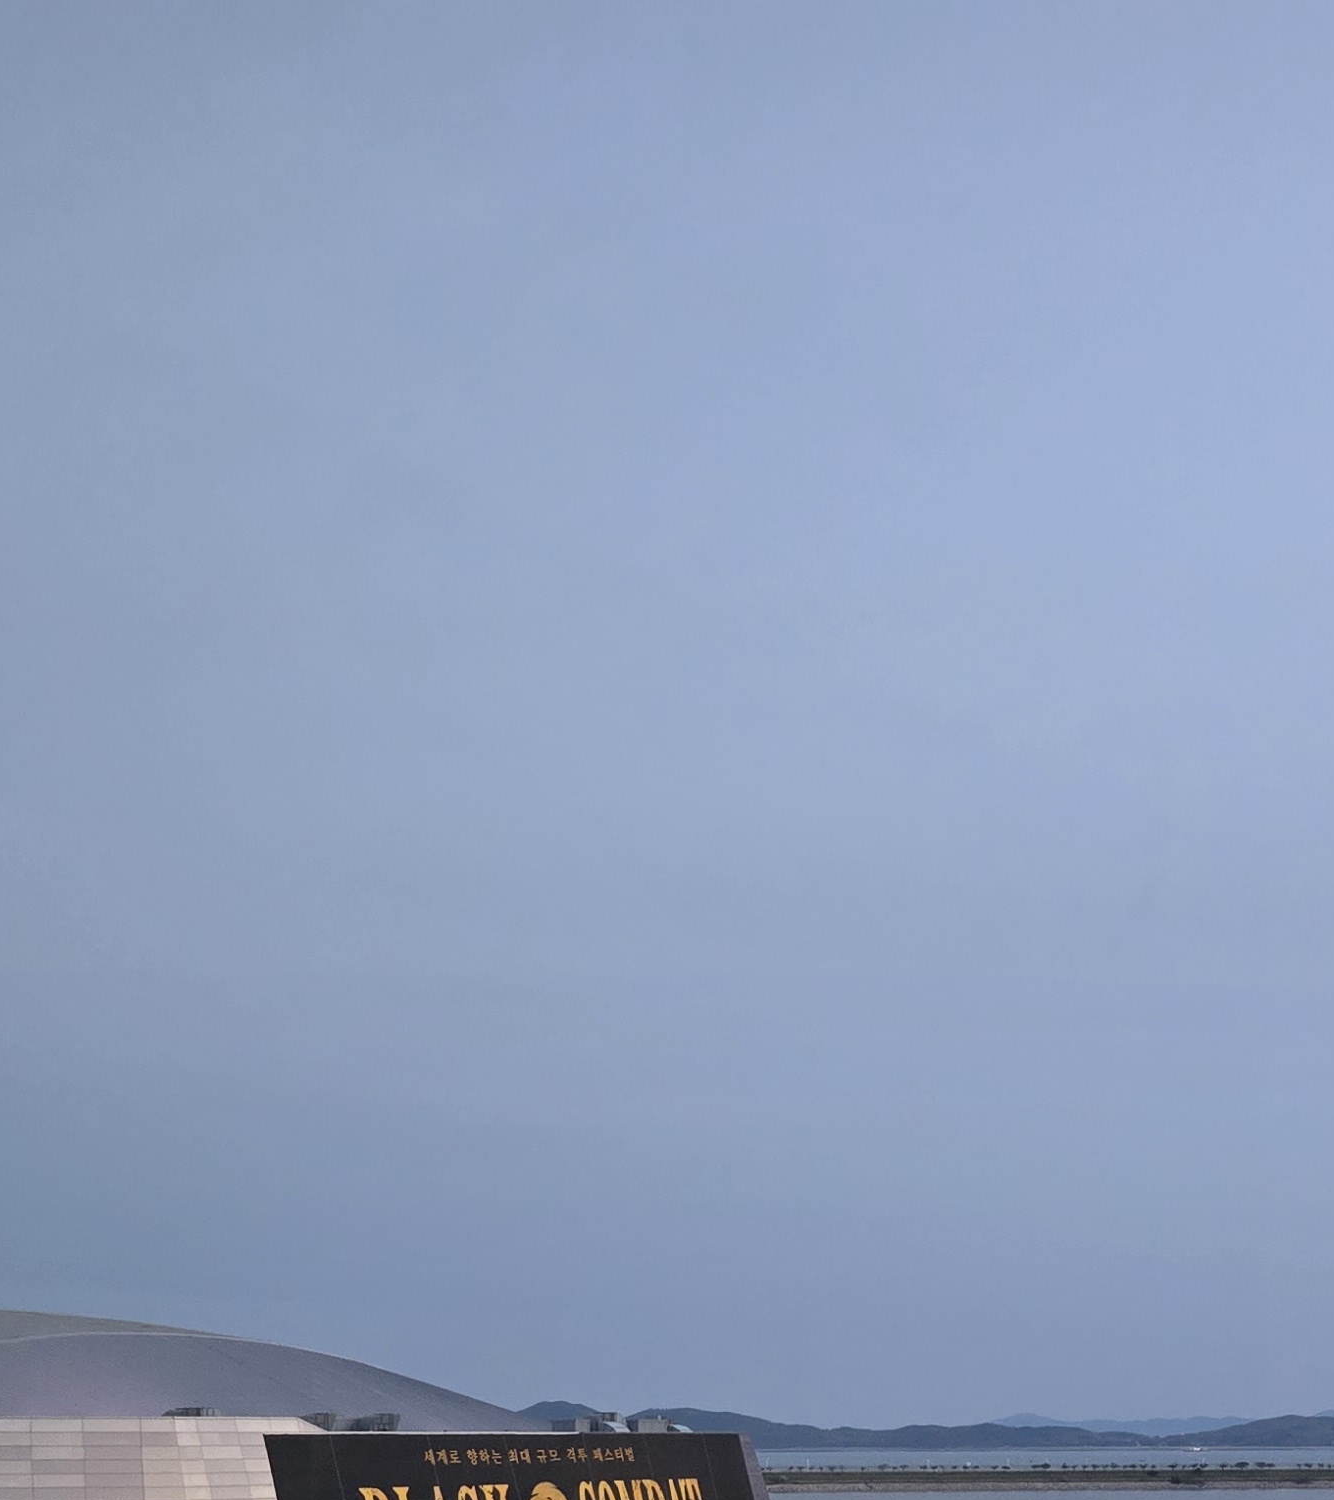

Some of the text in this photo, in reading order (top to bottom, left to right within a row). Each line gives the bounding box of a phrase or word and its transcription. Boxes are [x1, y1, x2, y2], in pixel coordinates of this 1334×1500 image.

[424, 1448, 461, 1466] 세계로
[467, 1448, 502, 1466] 향하는
[508, 1448, 531, 1465] 최대
[536, 1448, 561, 1463] 규모
[567, 1446, 587, 1463] 격투
